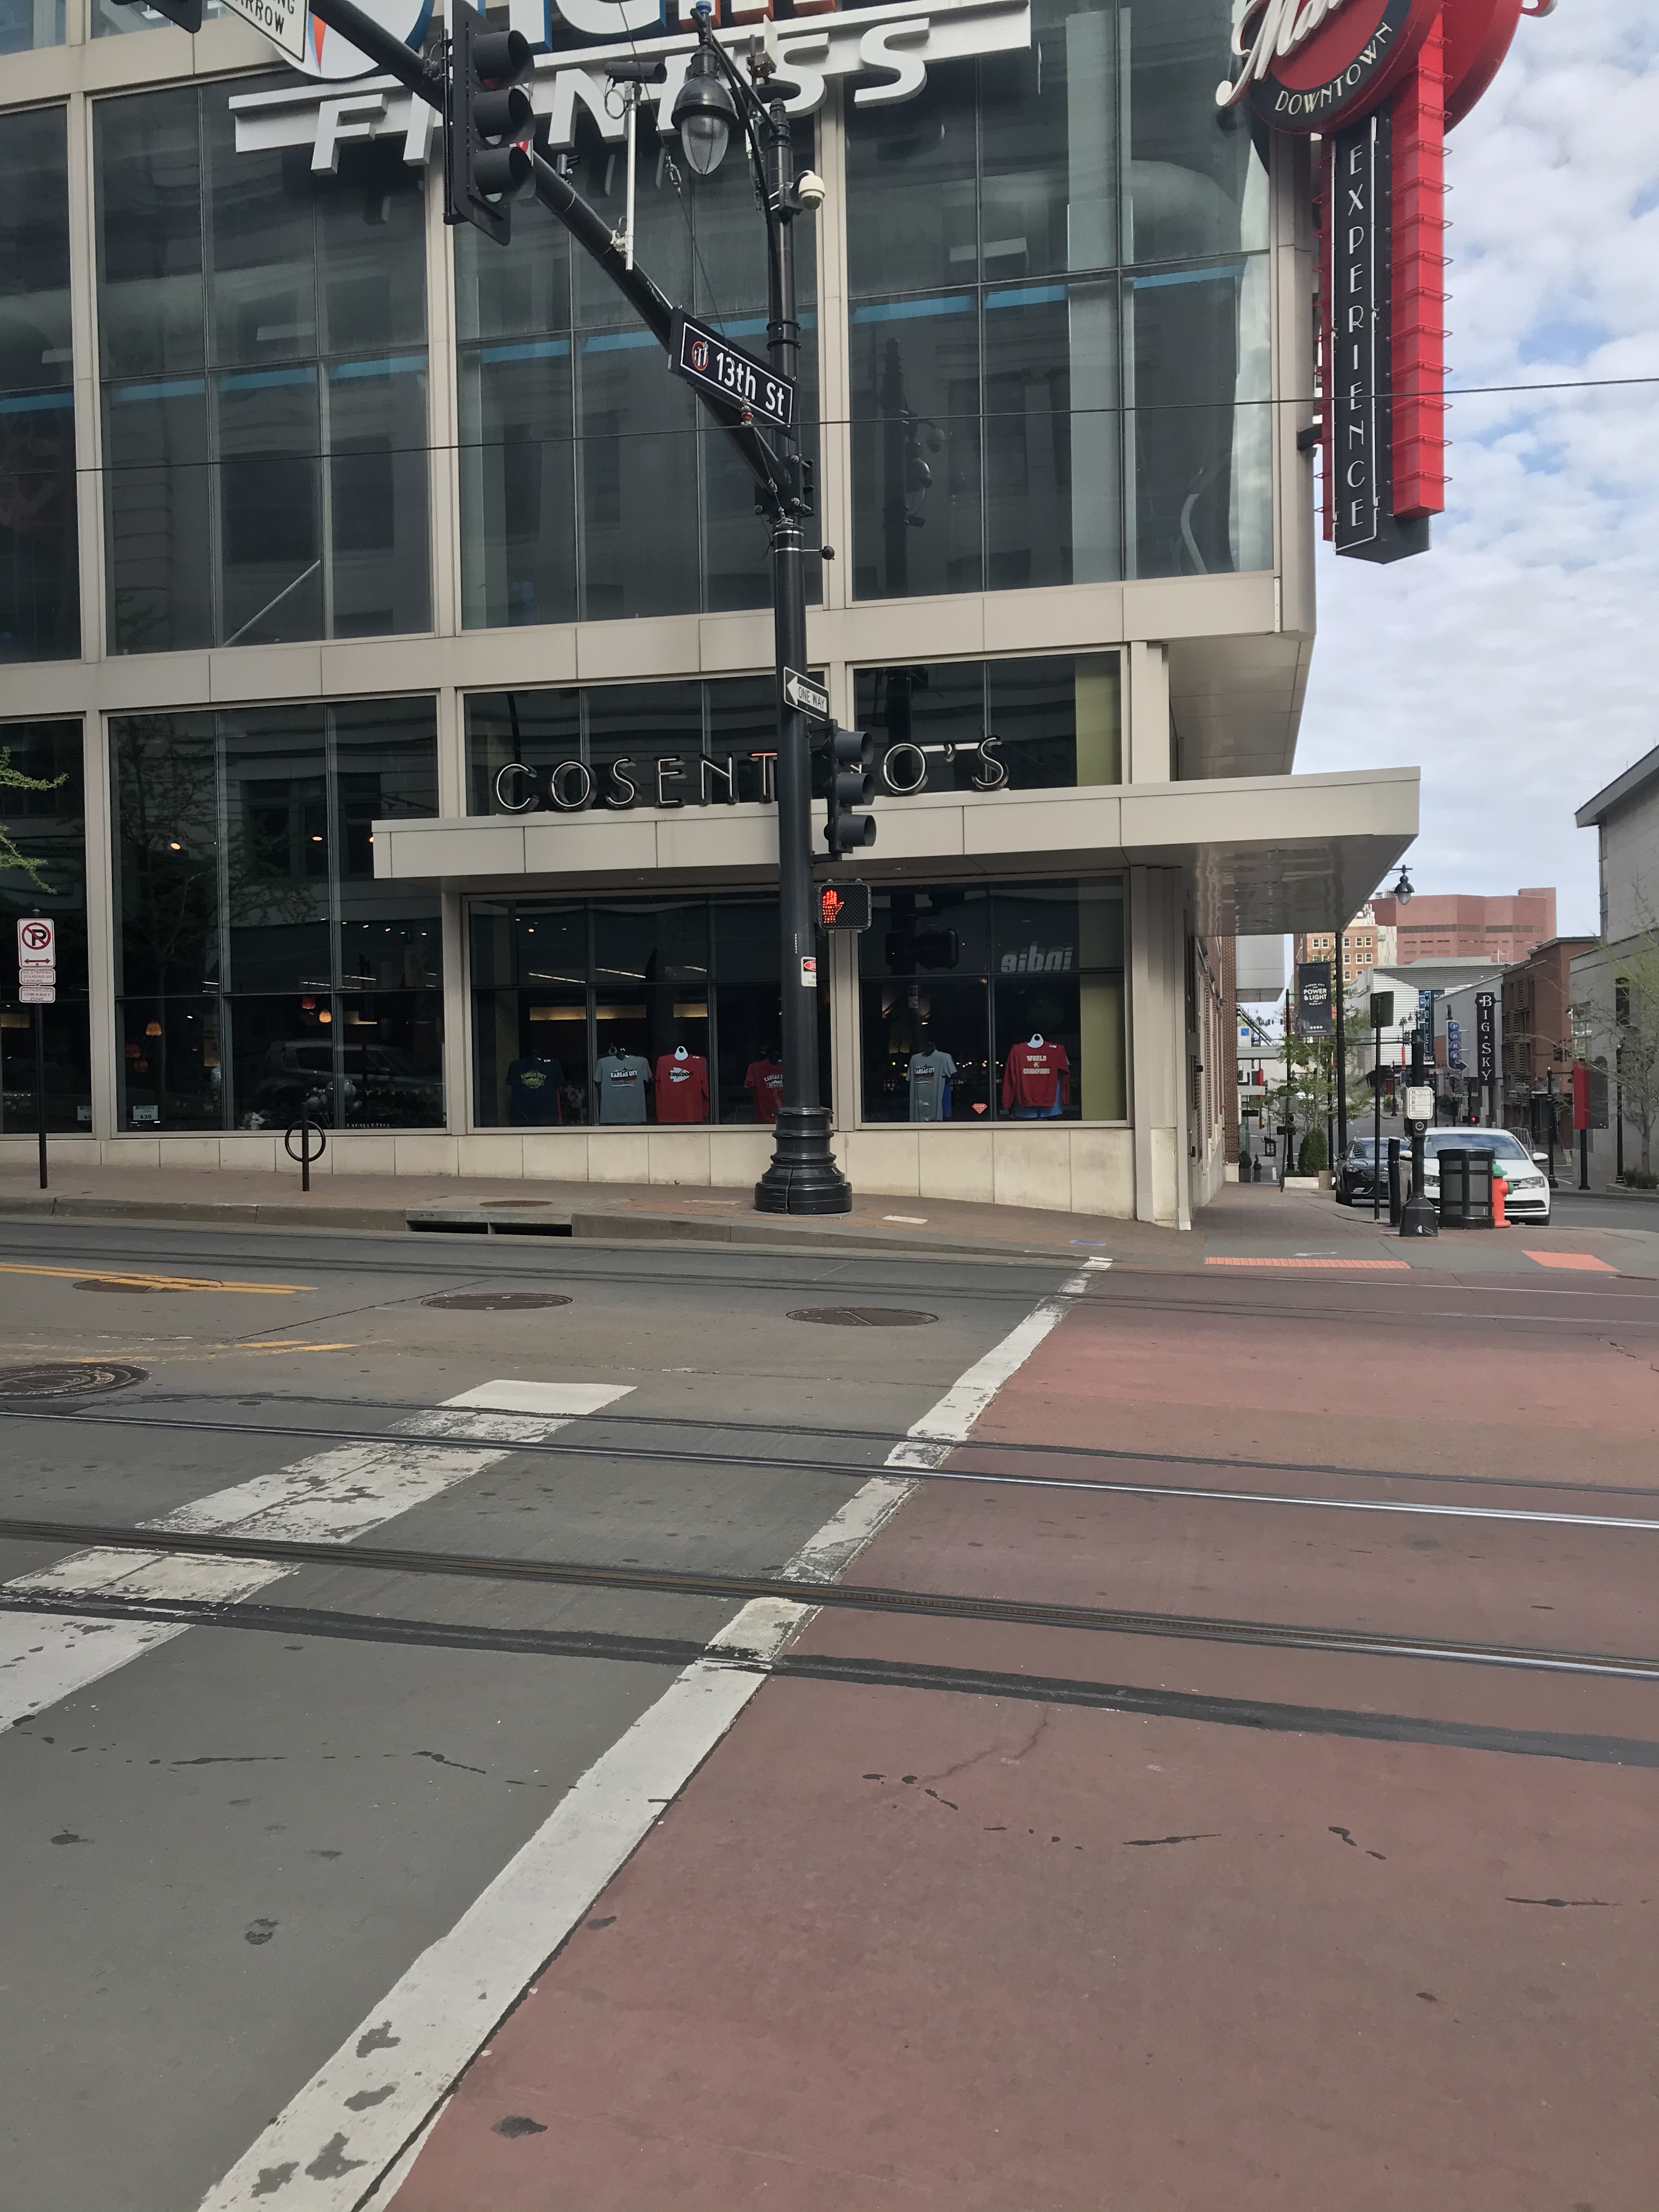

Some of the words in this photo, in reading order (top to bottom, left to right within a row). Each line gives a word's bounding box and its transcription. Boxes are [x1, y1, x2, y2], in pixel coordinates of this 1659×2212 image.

[236, 0, 285, 35] RROW
[1275, 22, 1392, 115] DOWNTOWN
[1347, 144, 1364, 528] EXPERIENCE
[716, 352, 757, 400] 13th
[765, 382, 785, 416] St
[798, 686, 810, 703] ONE
[812, 693, 825, 710] WAY
[494, 734, 1009, 814] COSENTO'S
[1481, 995, 1492, 1032] BIG
[1481, 1042, 1492, 1081] SKY
